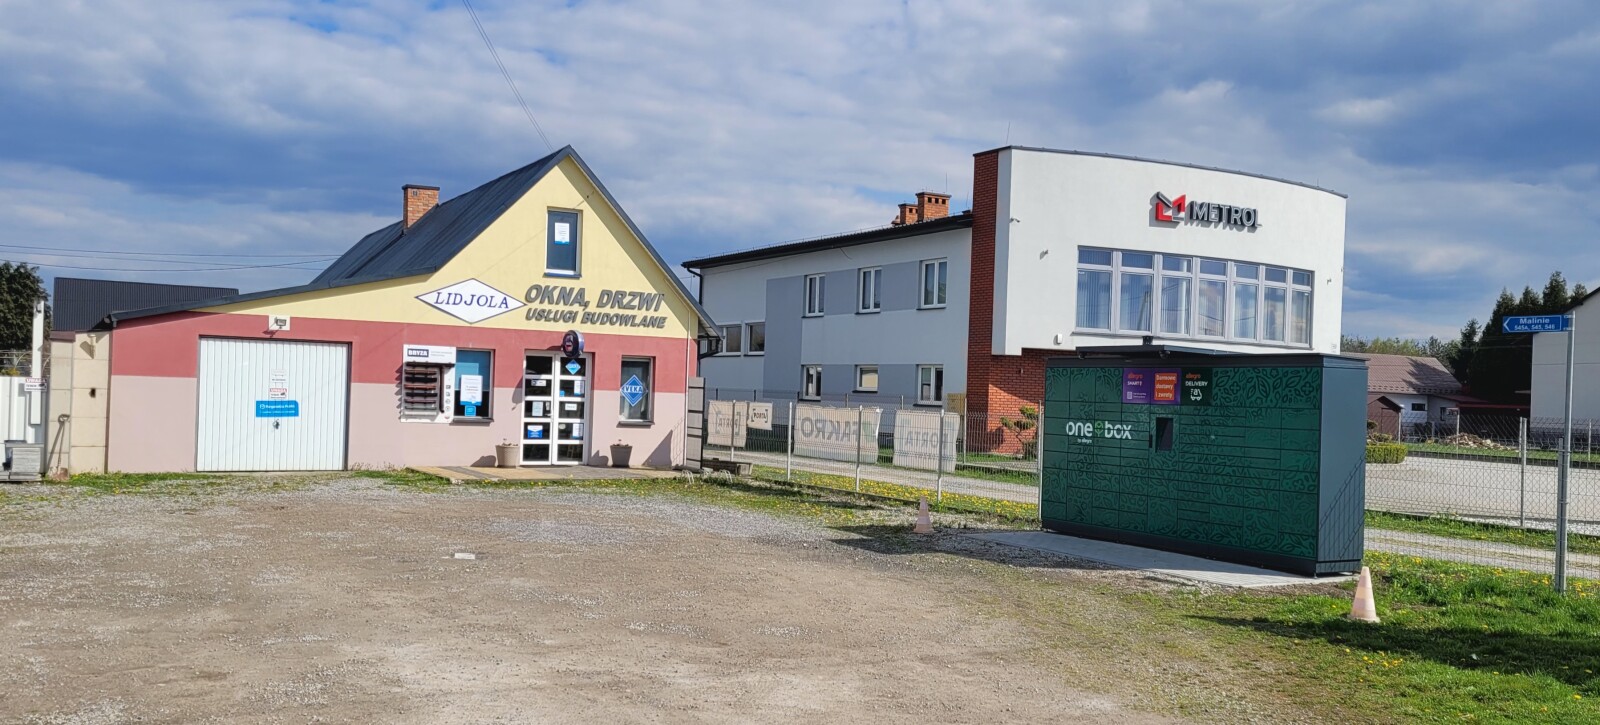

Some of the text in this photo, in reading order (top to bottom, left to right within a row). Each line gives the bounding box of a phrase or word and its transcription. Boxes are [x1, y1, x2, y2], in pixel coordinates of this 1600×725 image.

[1189, 200, 1263, 228] METROL
[433, 291, 510, 309] LIDJOLA
[525, 284, 664, 312] OKNA, DRZWI
[525, 307, 668, 329] USŁUGI BUDOWLANE
[623, 385, 643, 393] VEKA
[1066, 420, 1132, 439] one box
